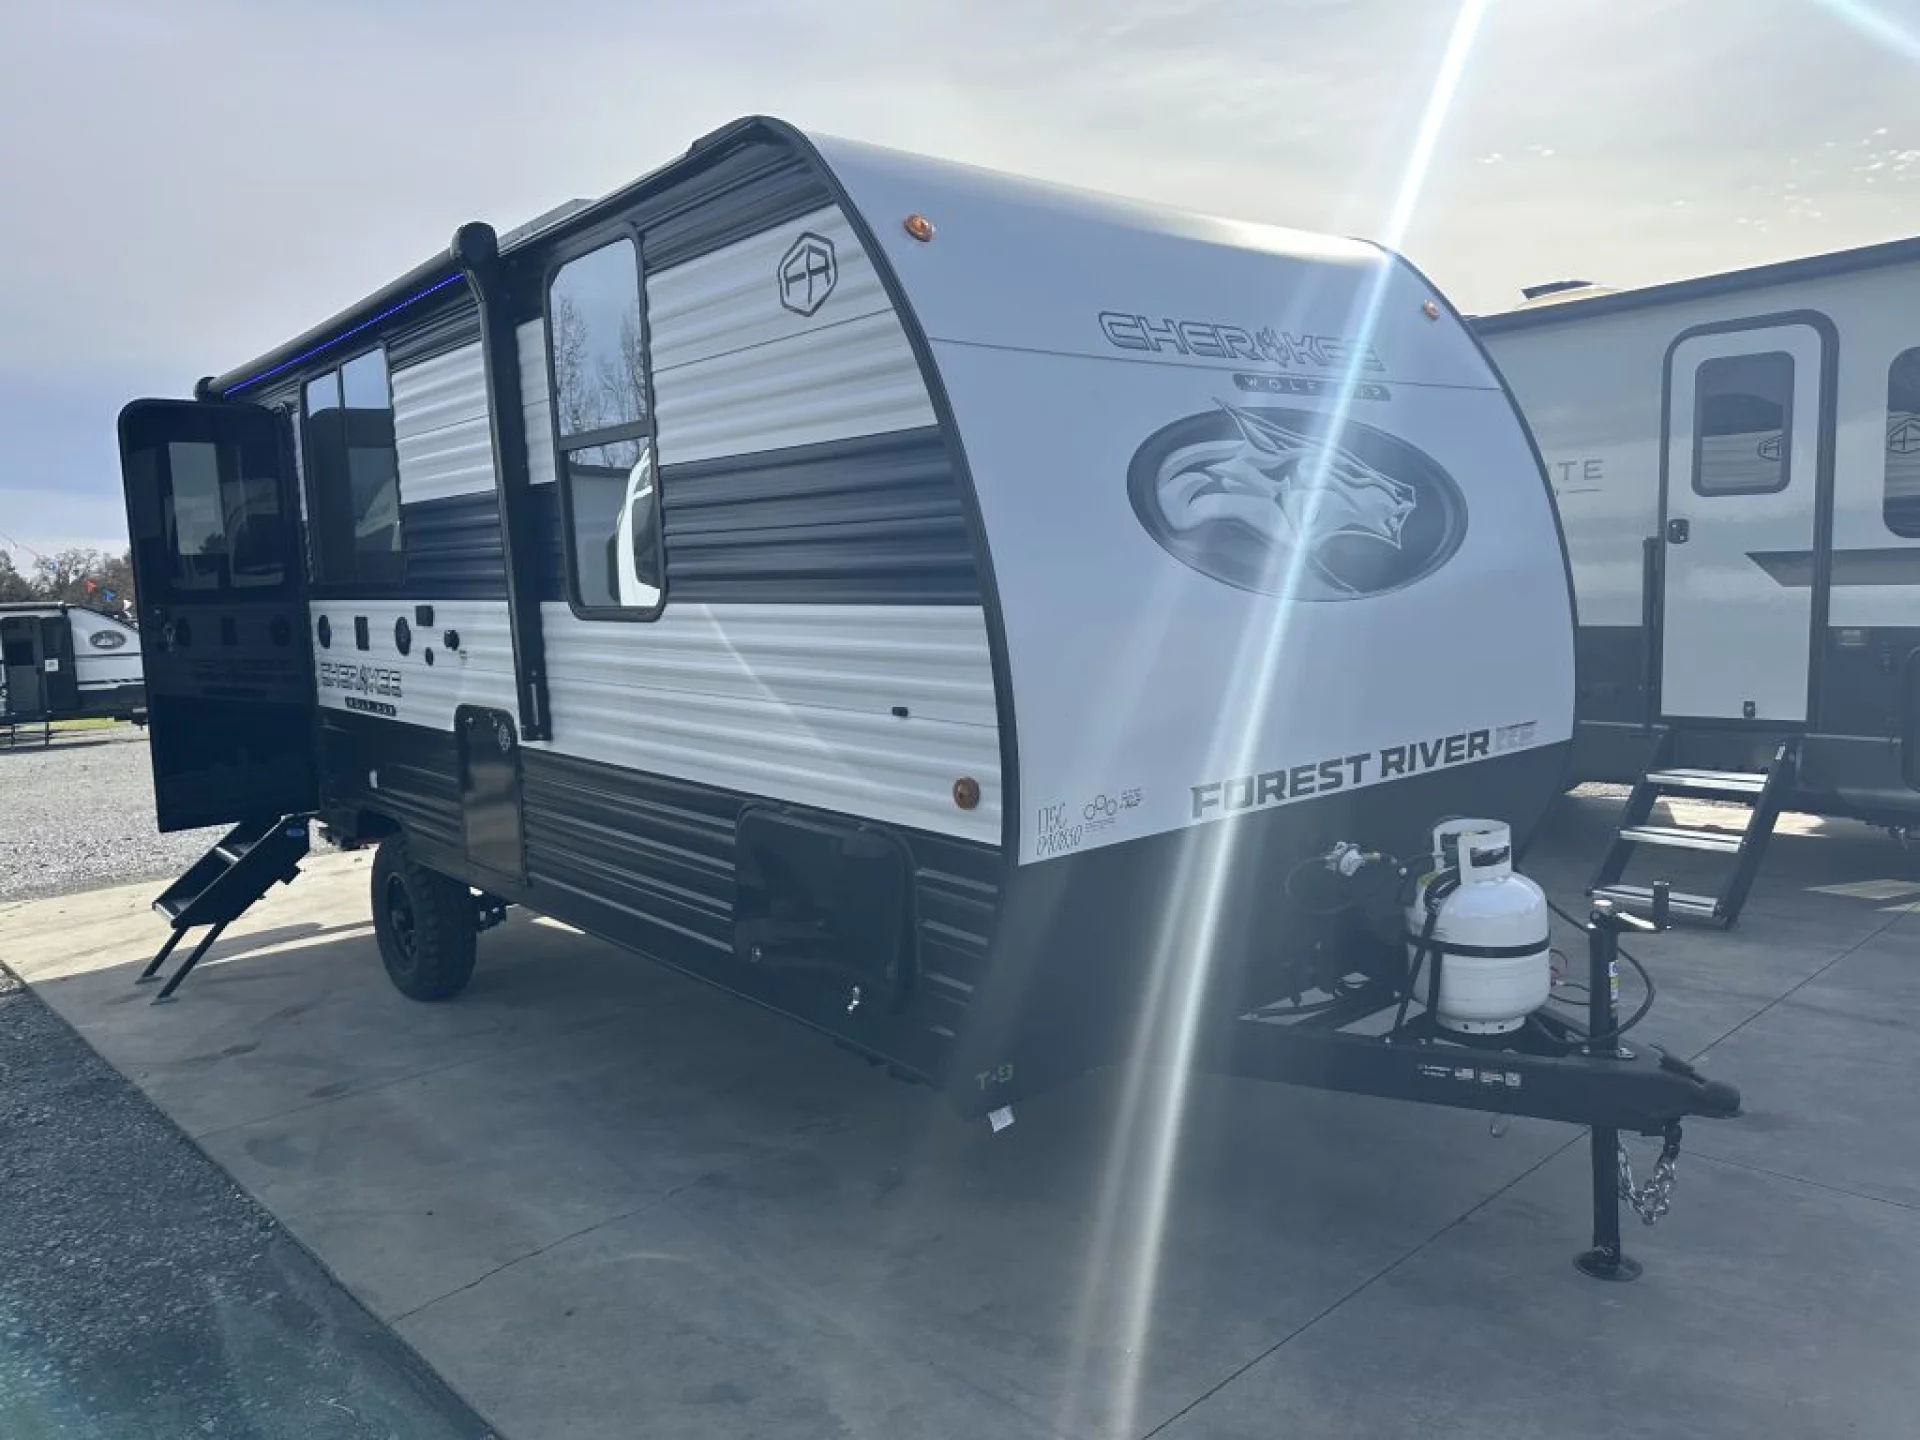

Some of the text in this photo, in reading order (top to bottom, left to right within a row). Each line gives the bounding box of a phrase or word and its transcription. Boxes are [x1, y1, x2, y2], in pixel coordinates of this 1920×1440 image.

[1557, 458, 1604, 481] TE
[1190, 751, 1371, 819] FOREST
[1380, 728, 1490, 778] RIVER
